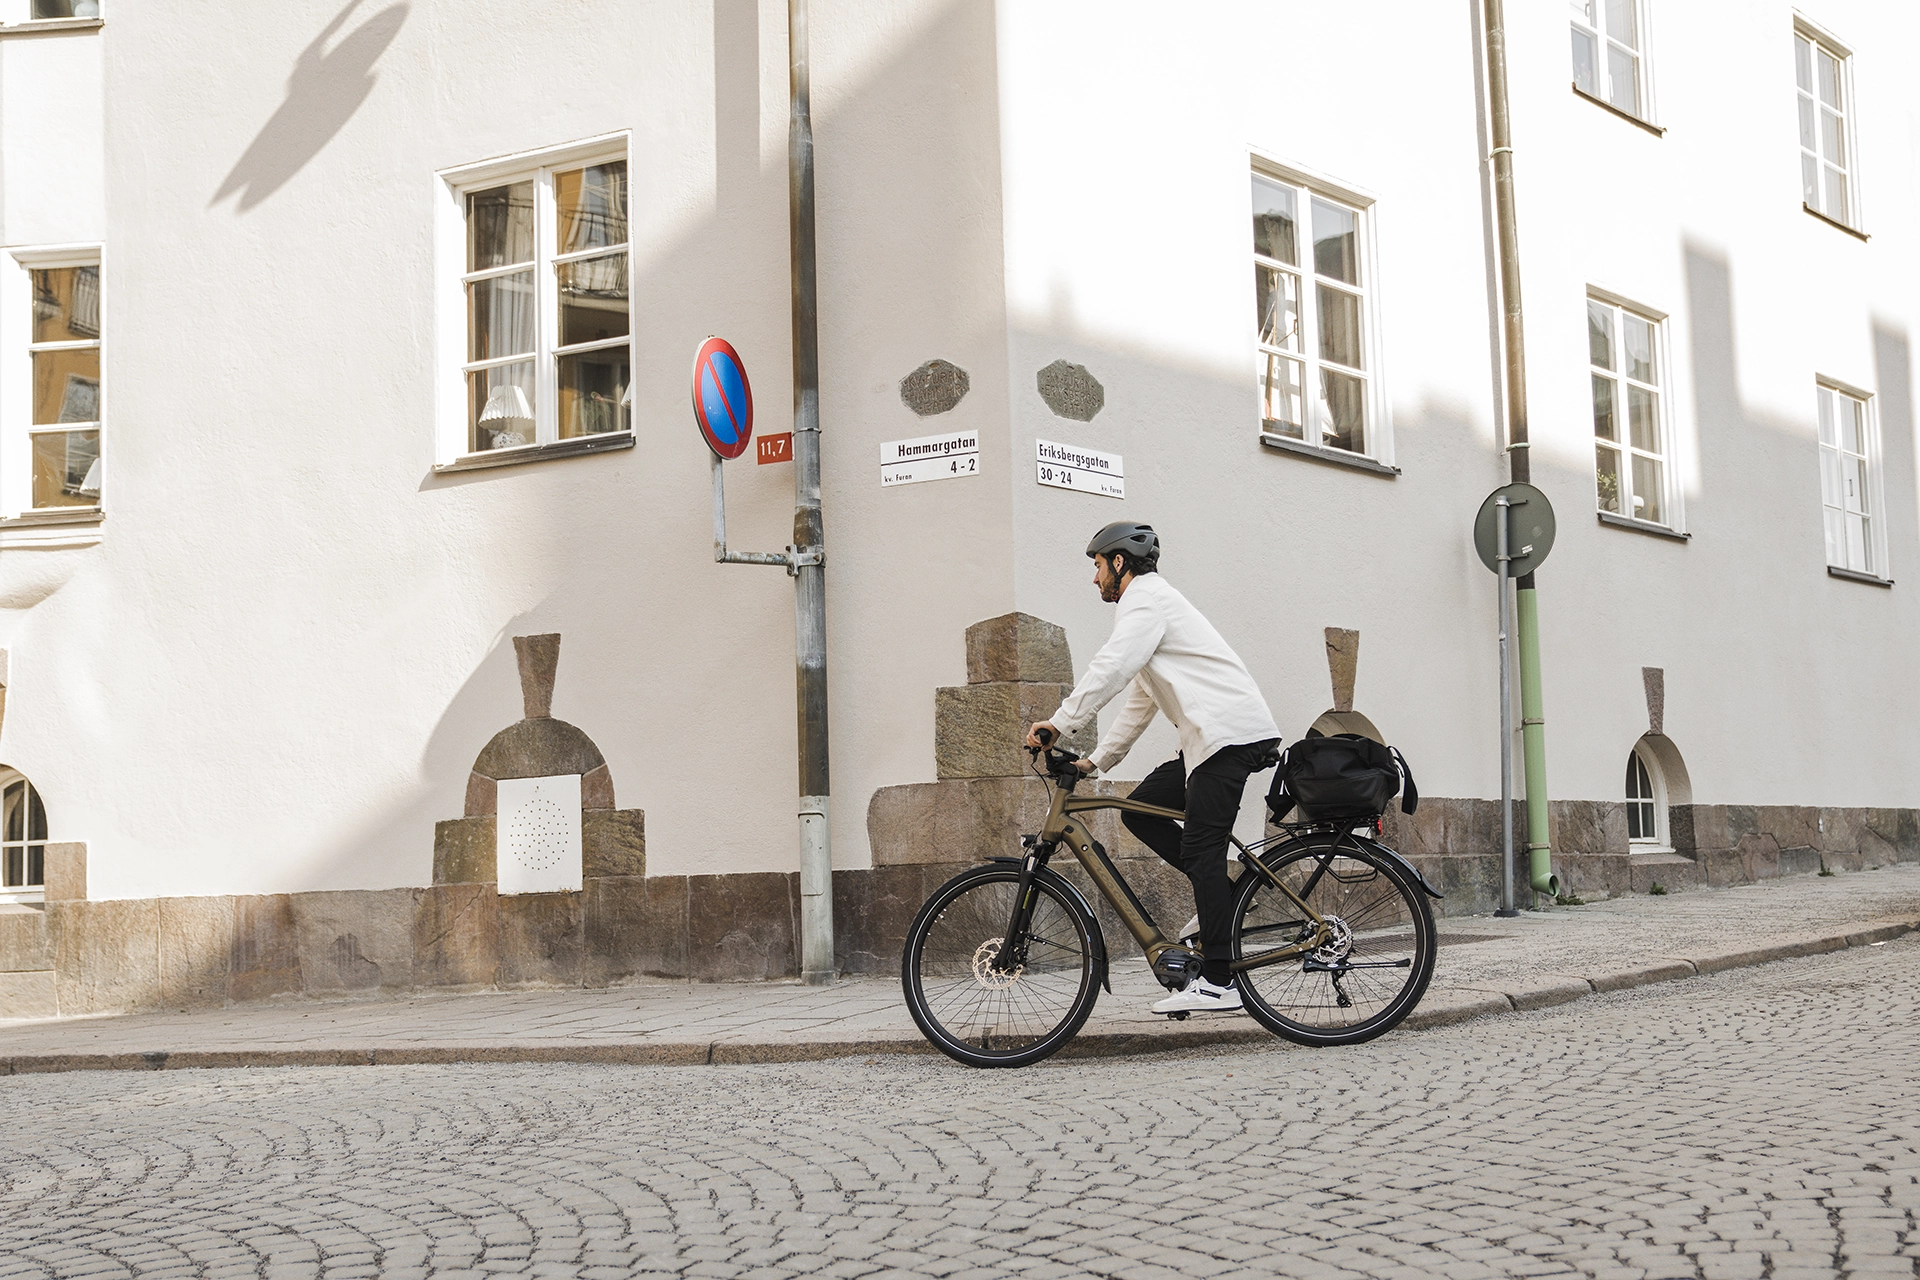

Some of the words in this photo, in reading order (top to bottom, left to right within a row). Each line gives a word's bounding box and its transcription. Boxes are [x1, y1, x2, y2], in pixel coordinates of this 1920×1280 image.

[761, 440, 785, 457] 11,7
[898, 438, 976, 457] Hammargatan
[1039, 444, 1109, 469] Eriksbergsgatan
[1086, 851, 1144, 926] Crescent
